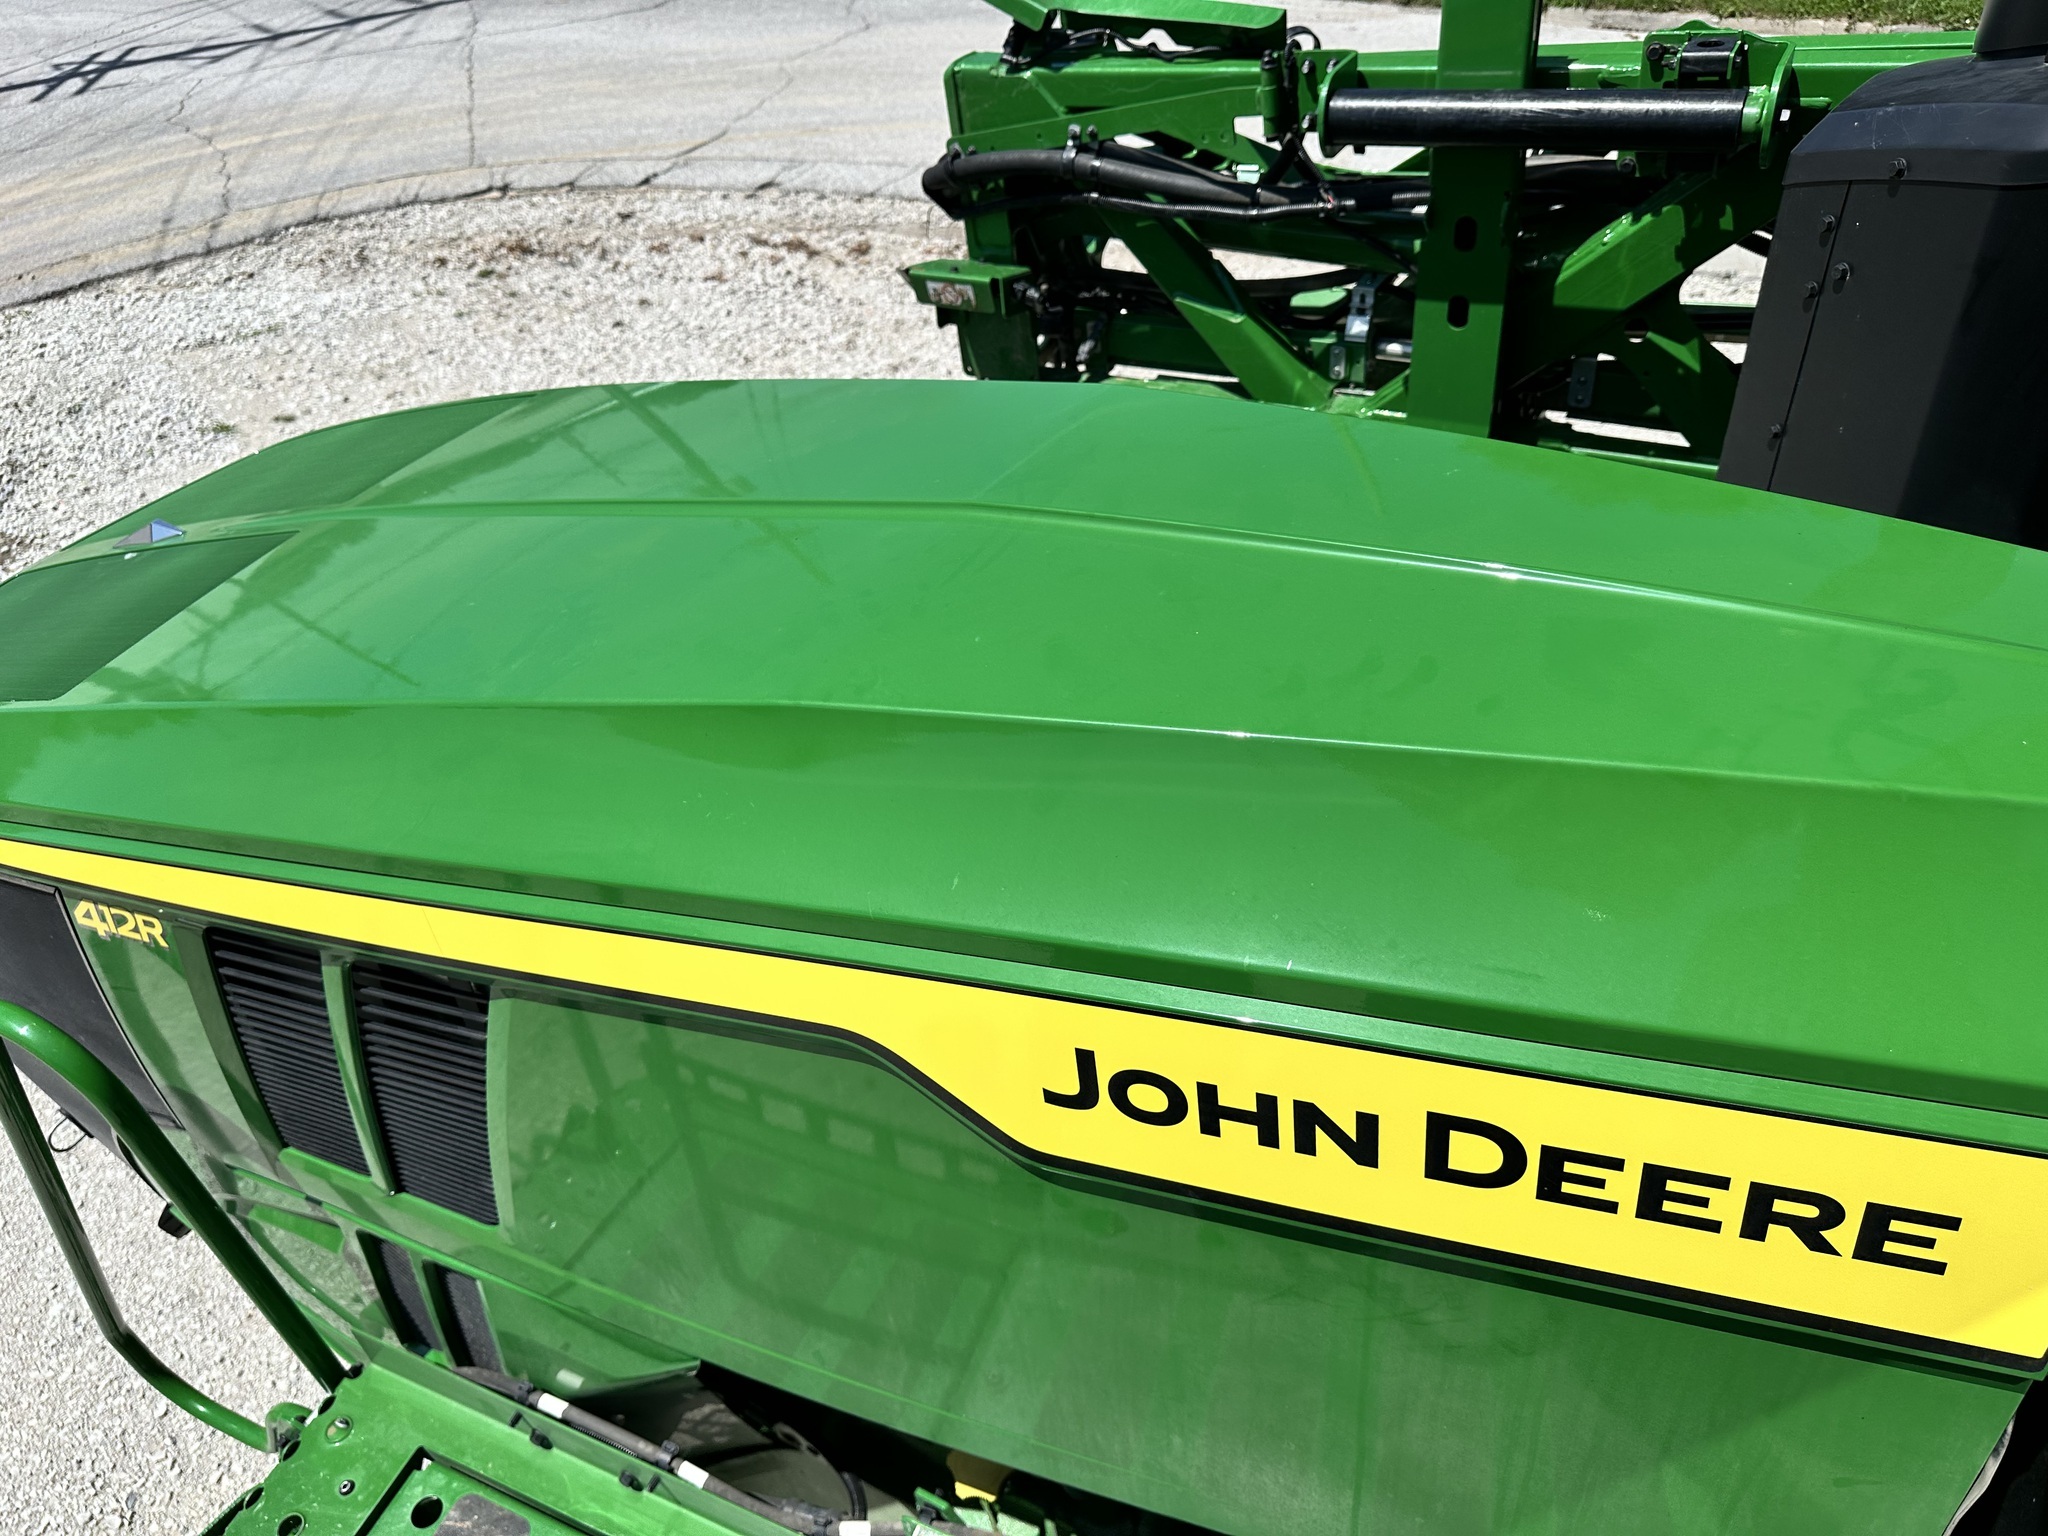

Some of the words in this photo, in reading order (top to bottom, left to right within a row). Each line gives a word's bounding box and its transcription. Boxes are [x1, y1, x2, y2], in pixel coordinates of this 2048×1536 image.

[74, 900, 168, 948] 412R
[1042, 1047, 1379, 1169] JOHN
[1424, 1111, 1962, 1276] DEERE
